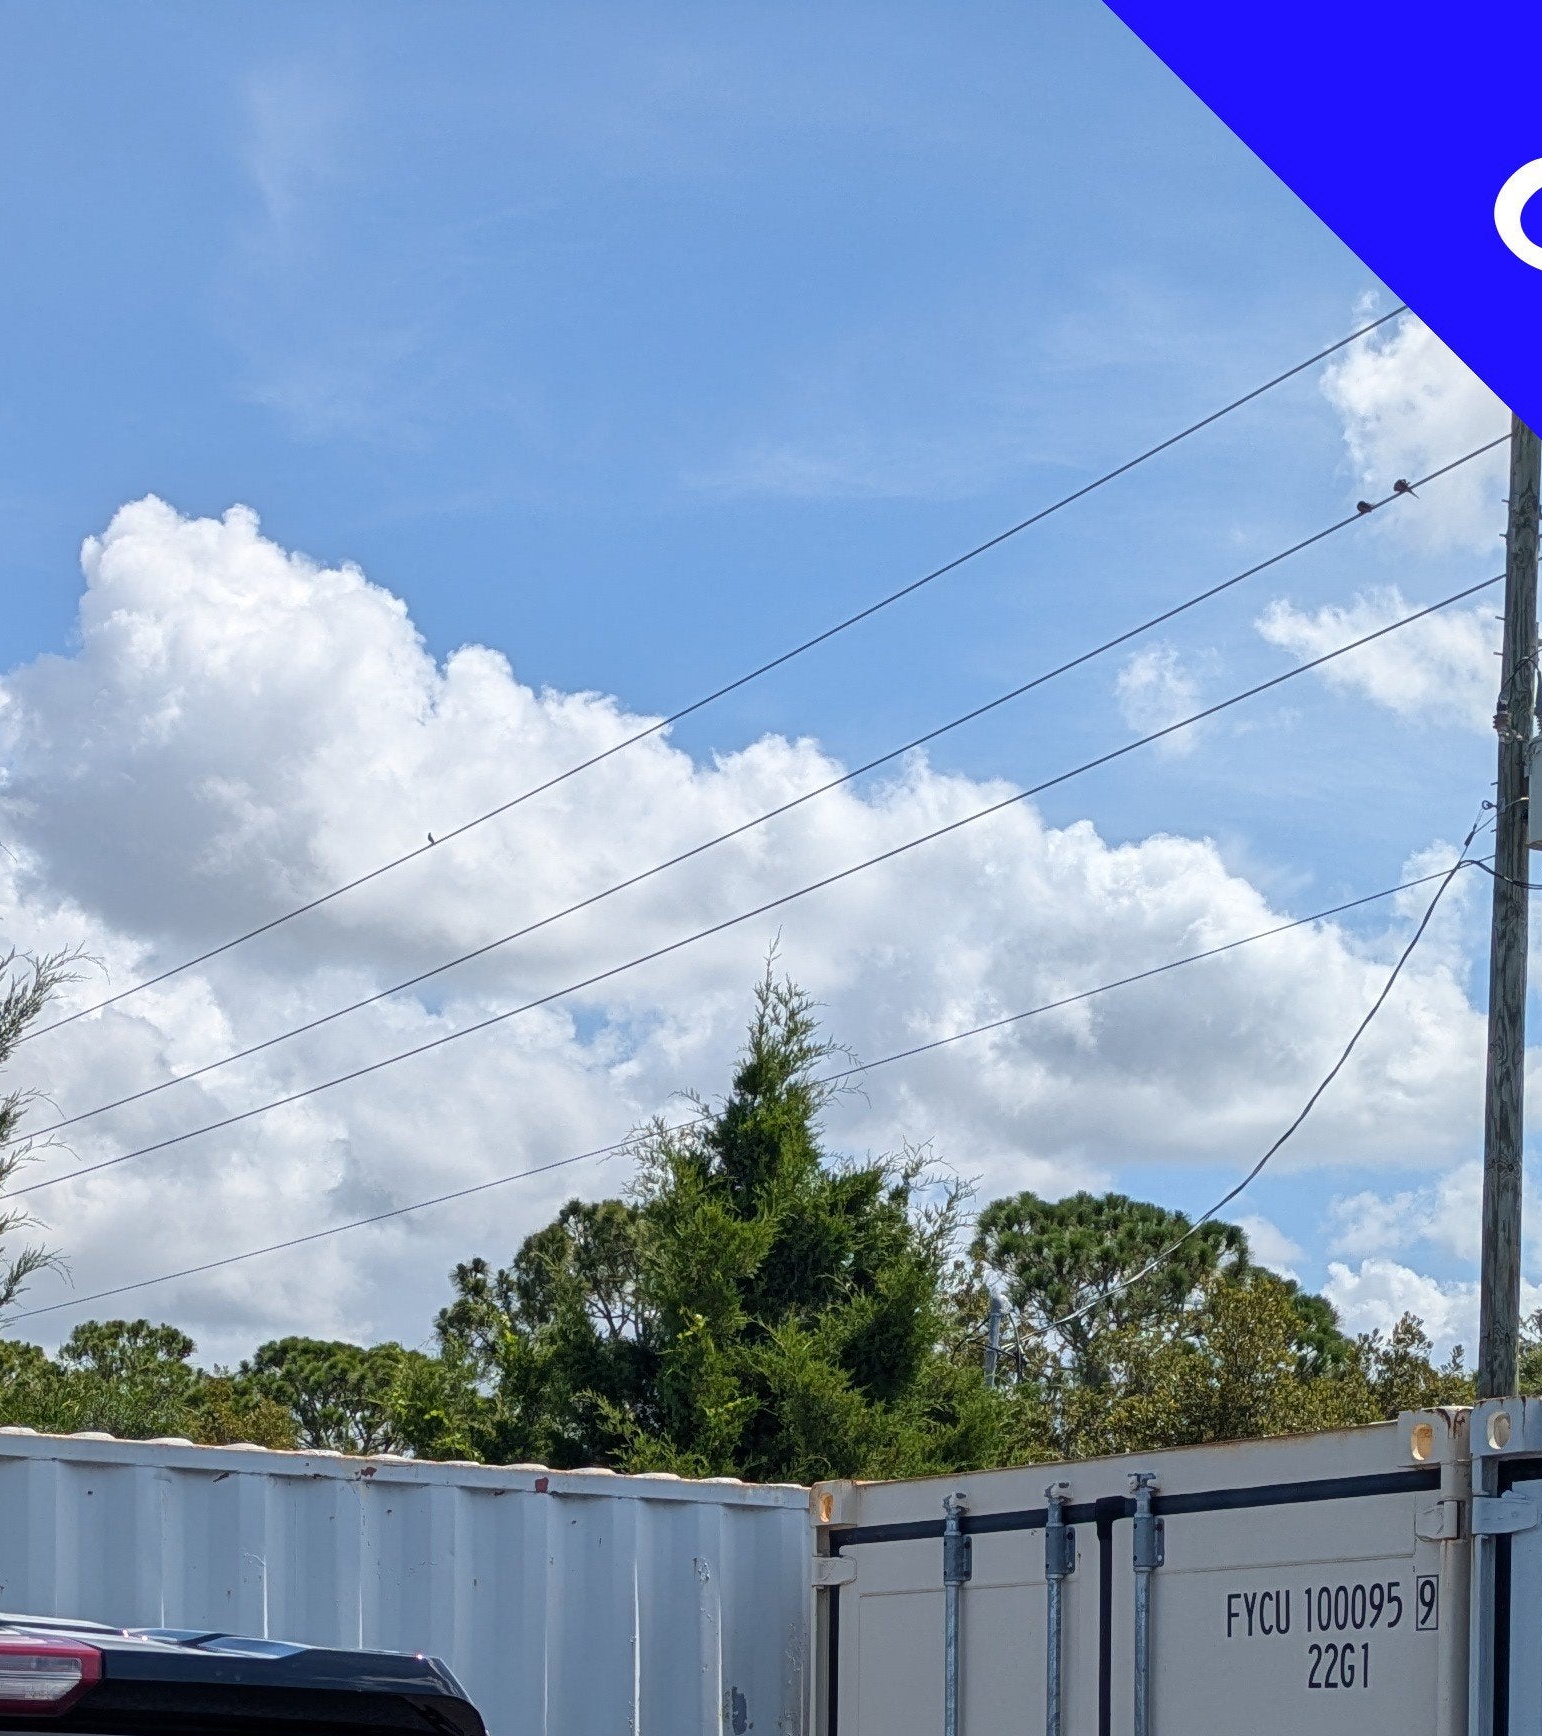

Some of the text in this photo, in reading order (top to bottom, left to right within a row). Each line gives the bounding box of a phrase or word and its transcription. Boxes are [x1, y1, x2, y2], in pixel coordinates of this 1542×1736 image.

[1228, 1579, 1436, 1637] FYCU 100095 9
[1309, 1643, 1368, 1688] 22G1
